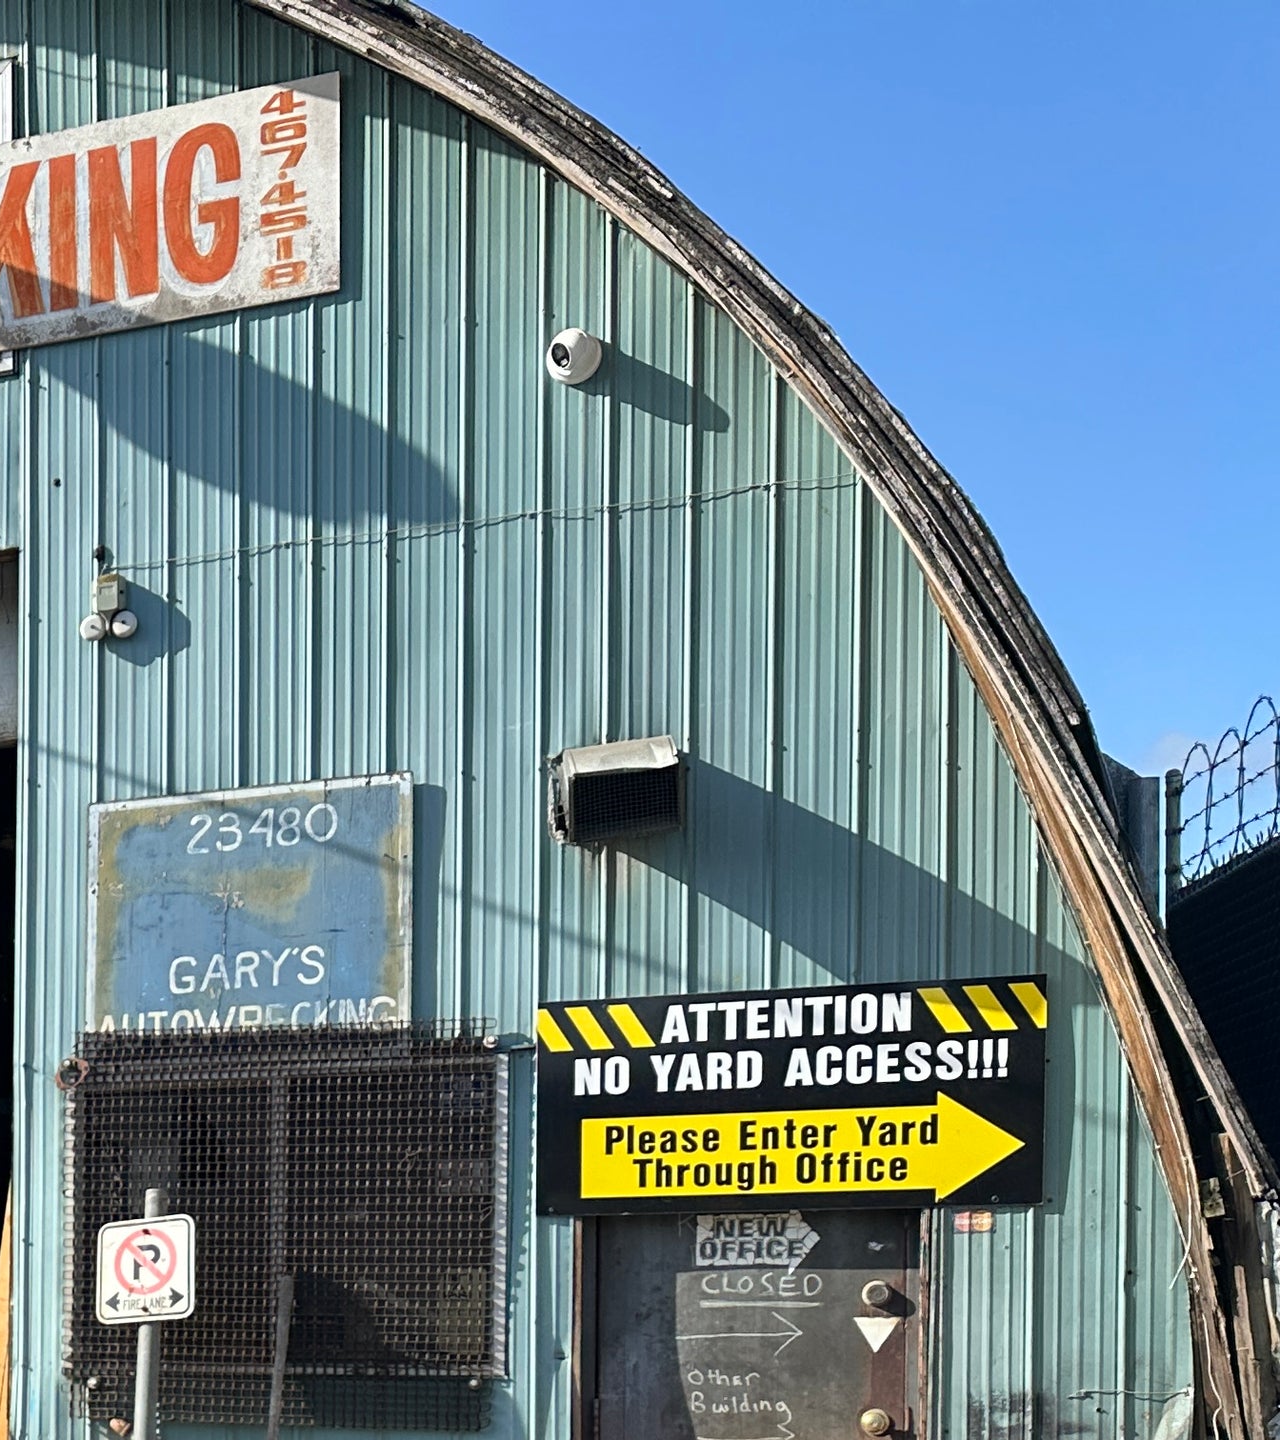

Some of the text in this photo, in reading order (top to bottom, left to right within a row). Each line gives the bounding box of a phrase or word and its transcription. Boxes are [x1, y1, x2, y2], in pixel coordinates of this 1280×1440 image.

[187, 803, 338, 855] 23480
[169, 944, 326, 994] GARY'S
[661, 992, 912, 1043] ATTENTION
[573, 1038, 1009, 1097] NO YARD ACCESS!!!
[604, 1113, 940, 1156] Please Enter Yard
[632, 1152, 908, 1191] Through Office
[715, 1215, 788, 1238] NEW
[699, 1238, 805, 1261] OFFICE
[122, 1297, 142, 1311] FIRE
[701, 1272, 822, 1297] CLOSED
[691, 1391, 792, 1426] Building
